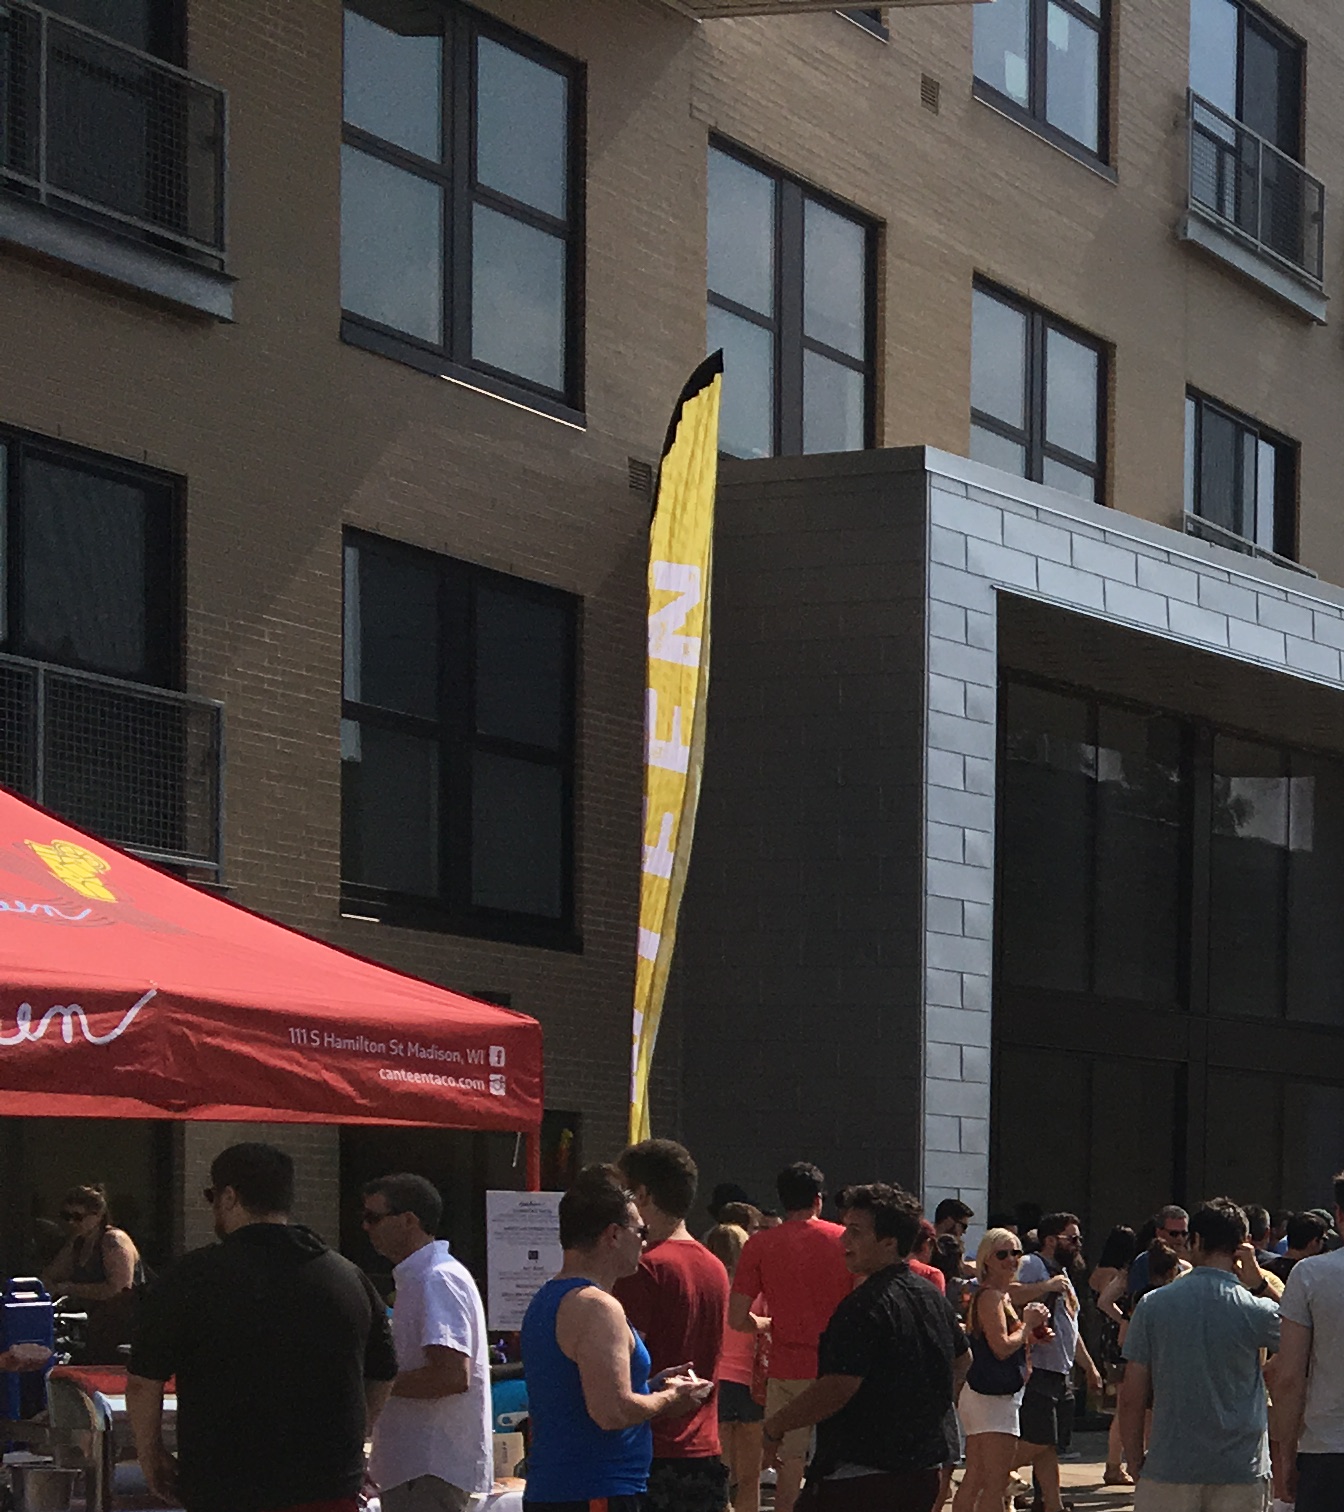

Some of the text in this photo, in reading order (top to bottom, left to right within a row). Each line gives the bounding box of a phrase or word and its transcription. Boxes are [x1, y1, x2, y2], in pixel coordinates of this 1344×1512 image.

[288, 1027, 485, 1065] 111 S Hamilton St Madison, WI
[379, 1068, 485, 1091] canteentaco.com
